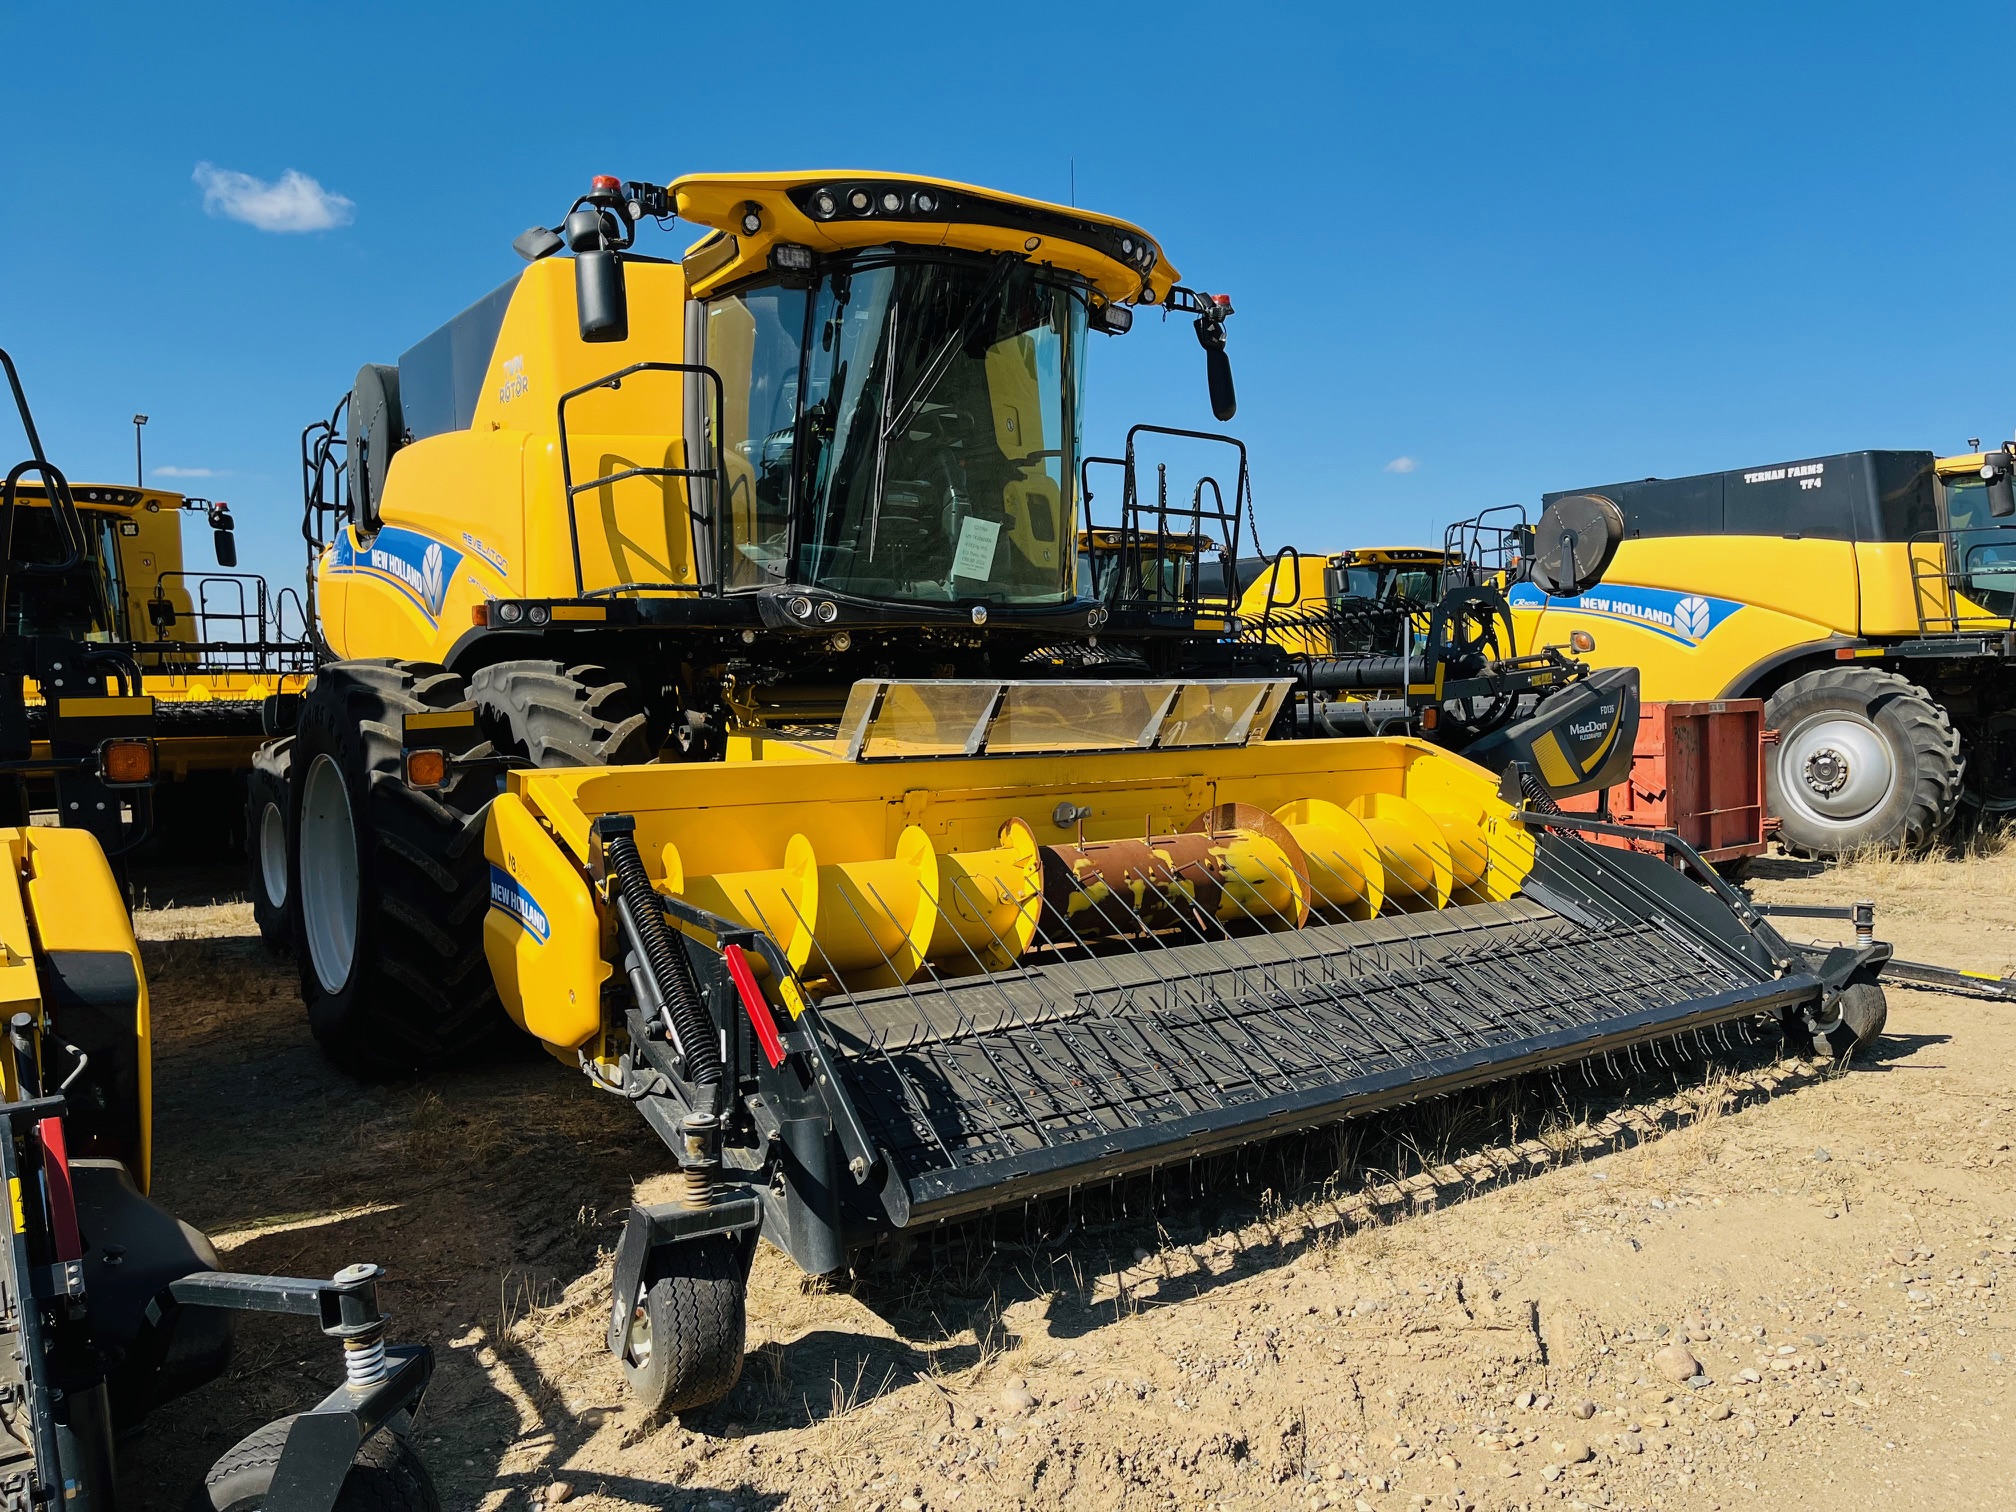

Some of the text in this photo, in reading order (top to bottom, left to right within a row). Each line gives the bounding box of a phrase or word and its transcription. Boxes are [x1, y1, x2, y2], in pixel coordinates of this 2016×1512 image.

[503, 354, 524, 379] TWIN
[499, 373, 528, 404] ROTOR
[1744, 463, 1823, 483] TERNAN FARMS
[1800, 478, 1821, 490] TF4
[463, 532, 508, 571] REVELATION
[372, 549, 388, 570] NEW
[389, 553, 422, 593] HOLLAND
[1580, 597, 1672, 626] NEW HOLLAND
[1600, 704, 1615, 715] FD135
[1569, 721, 1608, 735] MacDon
[491, 882, 546, 934] NEW HOLLAND
